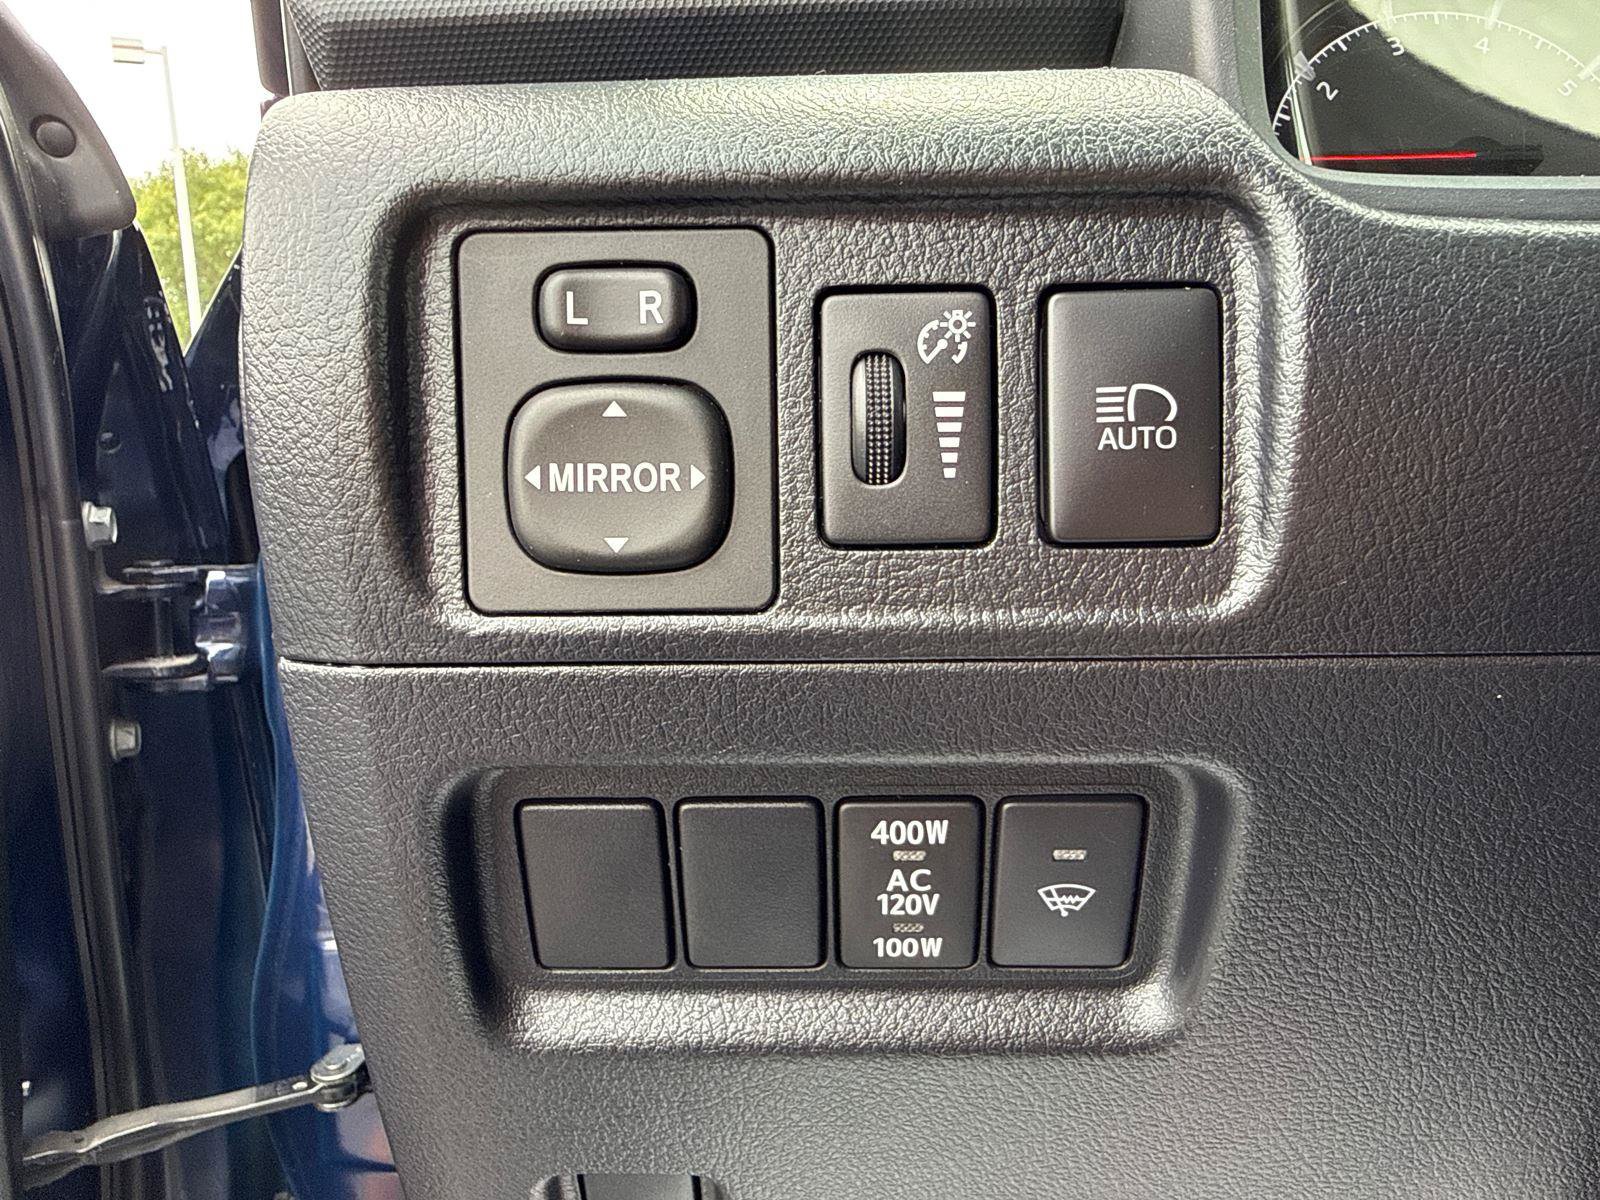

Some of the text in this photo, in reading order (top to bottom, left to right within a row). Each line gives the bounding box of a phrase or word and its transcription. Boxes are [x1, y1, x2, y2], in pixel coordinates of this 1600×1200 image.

[1387, 36, 1405, 57] 3
[1474, 36, 1490, 54] 4
[1316, 80, 1339, 101] 2
[1557, 79, 1578, 97] 5
[565, 289, 664, 325] L R
[1097, 424, 1178, 451] AUTO
[549, 461, 682, 493] MIRROR
[870, 819, 949, 845] 400W
[886, 868, 932, 892] AC
[876, 893, 940, 916] 120V
[872, 936, 943, 958] 100W
